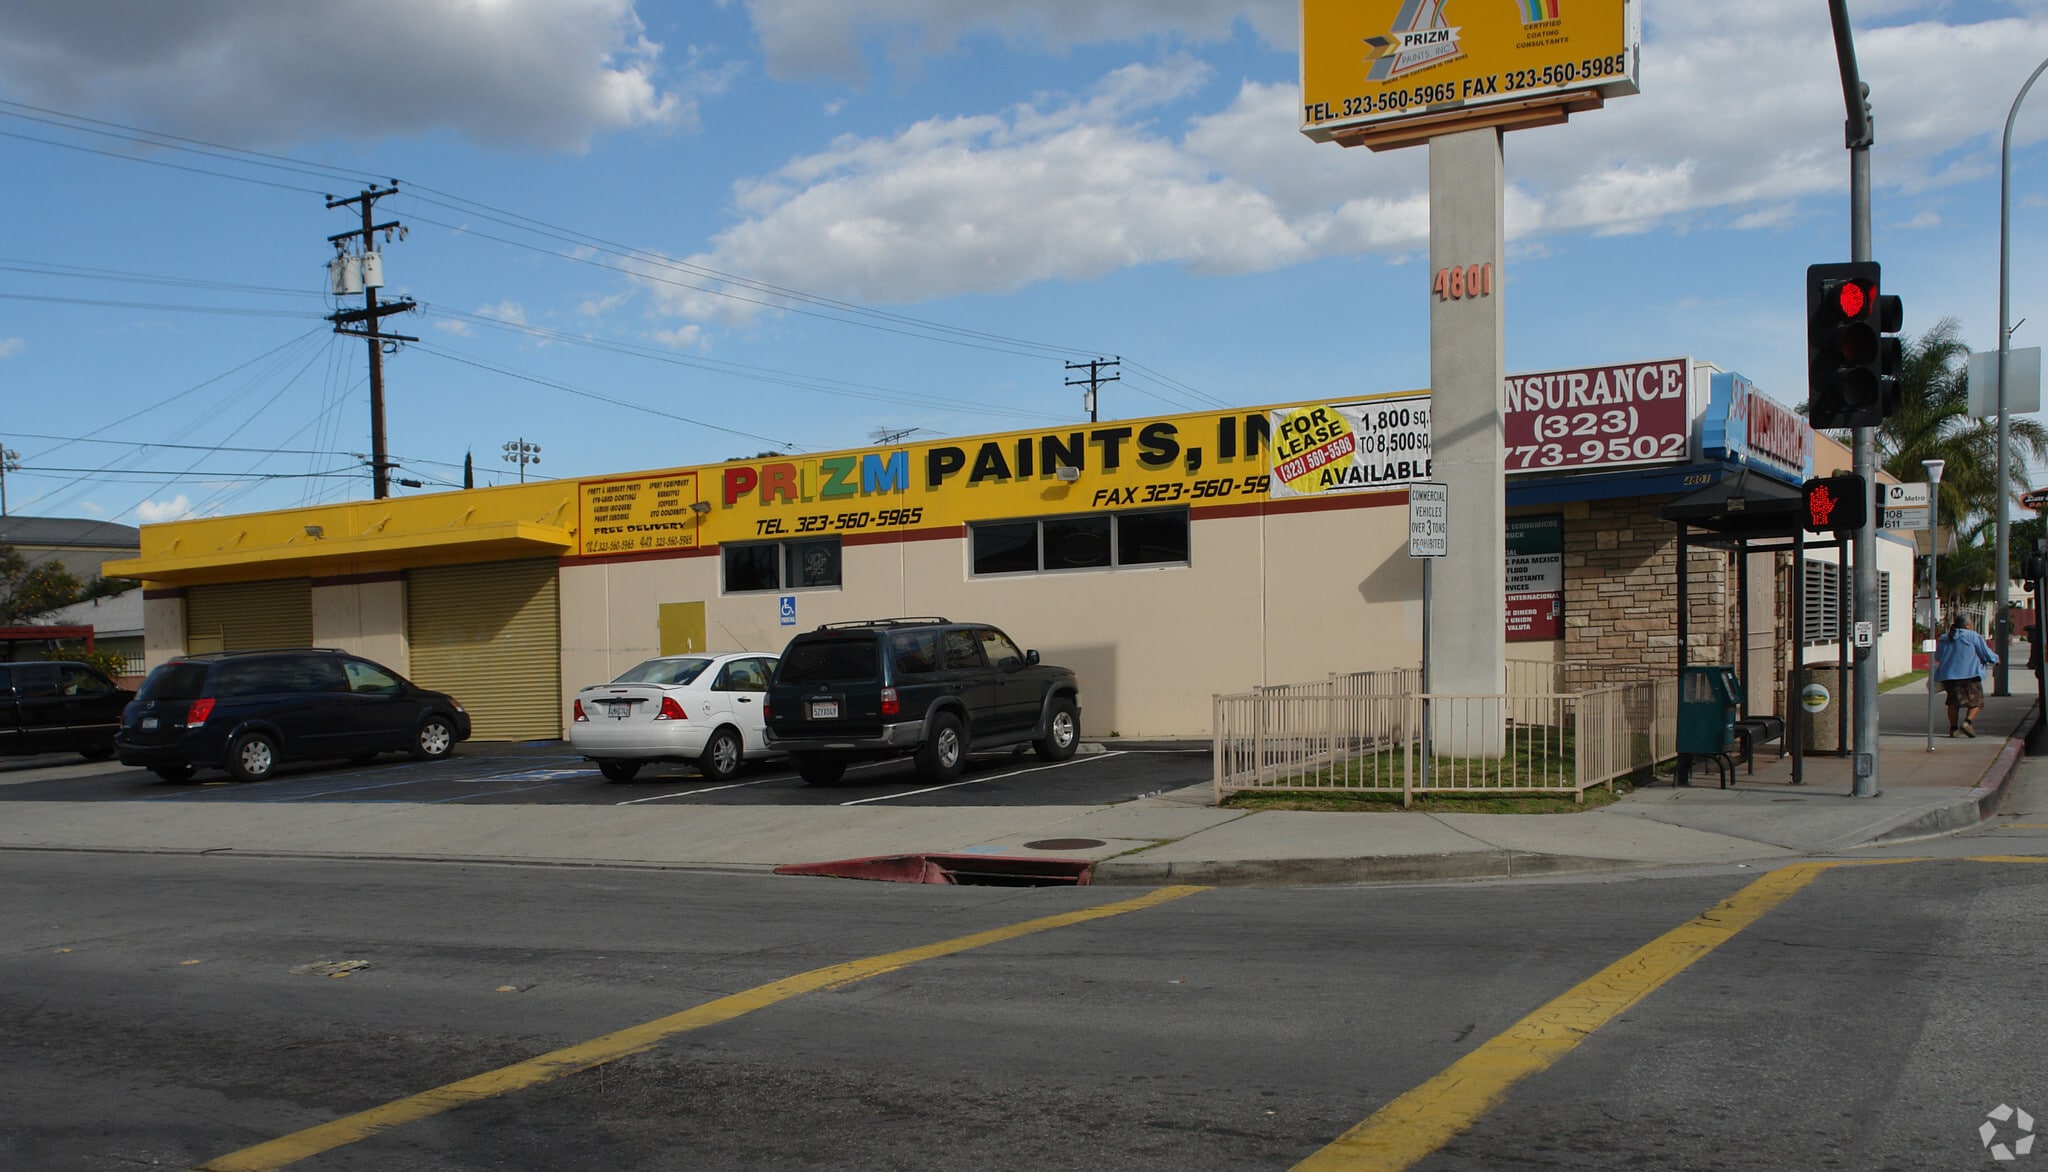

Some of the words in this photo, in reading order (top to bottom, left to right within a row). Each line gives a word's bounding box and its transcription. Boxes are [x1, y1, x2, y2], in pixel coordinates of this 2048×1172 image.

[1523, 20, 1562, 31] CERTIFIED
[1404, 29, 1449, 47] PRIZM
[1526, 29, 1559, 39] COATING
[1515, 36, 1569, 49] CONSULTANTS
[1400, 72, 1410, 80] THE
[1410, 63, 1437, 77] CUSTOMER
[1305, 102, 1340, 122] TEL.
[1342, 82, 1455, 117] 323-560-5965
[1462, 75, 1498, 98] FAX
[1504, 54, 1625, 91] 323-560-5985
[1434, 262, 1491, 300] 4801
[1280, 407, 1329, 441] FOR
[1361, 408, 1410, 434] 1,800
[1533, 406, 1639, 443] (323)
[1277, 420, 1343, 461] LEASE
[1360, 436, 1374, 454] TO
[1377, 431, 1415, 457] 8,500
[723, 450, 910, 506] PRIZM
[928, 421, 1203, 487] PAINTS,
[1280, 461, 1306, 482] (323)
[1308, 435, 1352, 469] 560-5598
[664, 478, 689, 487] EQUIPMENT
[1683, 473, 1712, 486] 4801
[1092, 486, 1139, 508] FAX
[1141, 474, 1271, 503] 323-560-59
[1412, 489, 1446, 502] COMMERCIAL
[1415, 505, 1443, 518] VEHICLES
[1886, 510, 1903, 519] 108
[756, 517, 789, 535] TEL.
[794, 506, 924, 534] 323-560-5965
[1511, 520, 1559, 530] ECONOMICOS
[1884, 520, 1900, 529] 611
[593, 525, 623, 535] FREE
[627, 521, 687, 533] DELIVERY
[1411, 522, 1426, 533] OVER
[1426, 519, 1432, 537] 3
[1432, 522, 1446, 534] TONS
[1412, 538, 1445, 549] PROHIBITED
[1511, 558, 1530, 566] PARA
[1531, 556, 1560, 564] MEXICO
[1506, 566, 1529, 574] FLOOD
[1511, 574, 1545, 582] INSTANTE
[1508, 593, 1560, 601] INTERNACIONAL
[1512, 608, 1538, 616] DINERO
[1510, 616, 1533, 624] UNION
